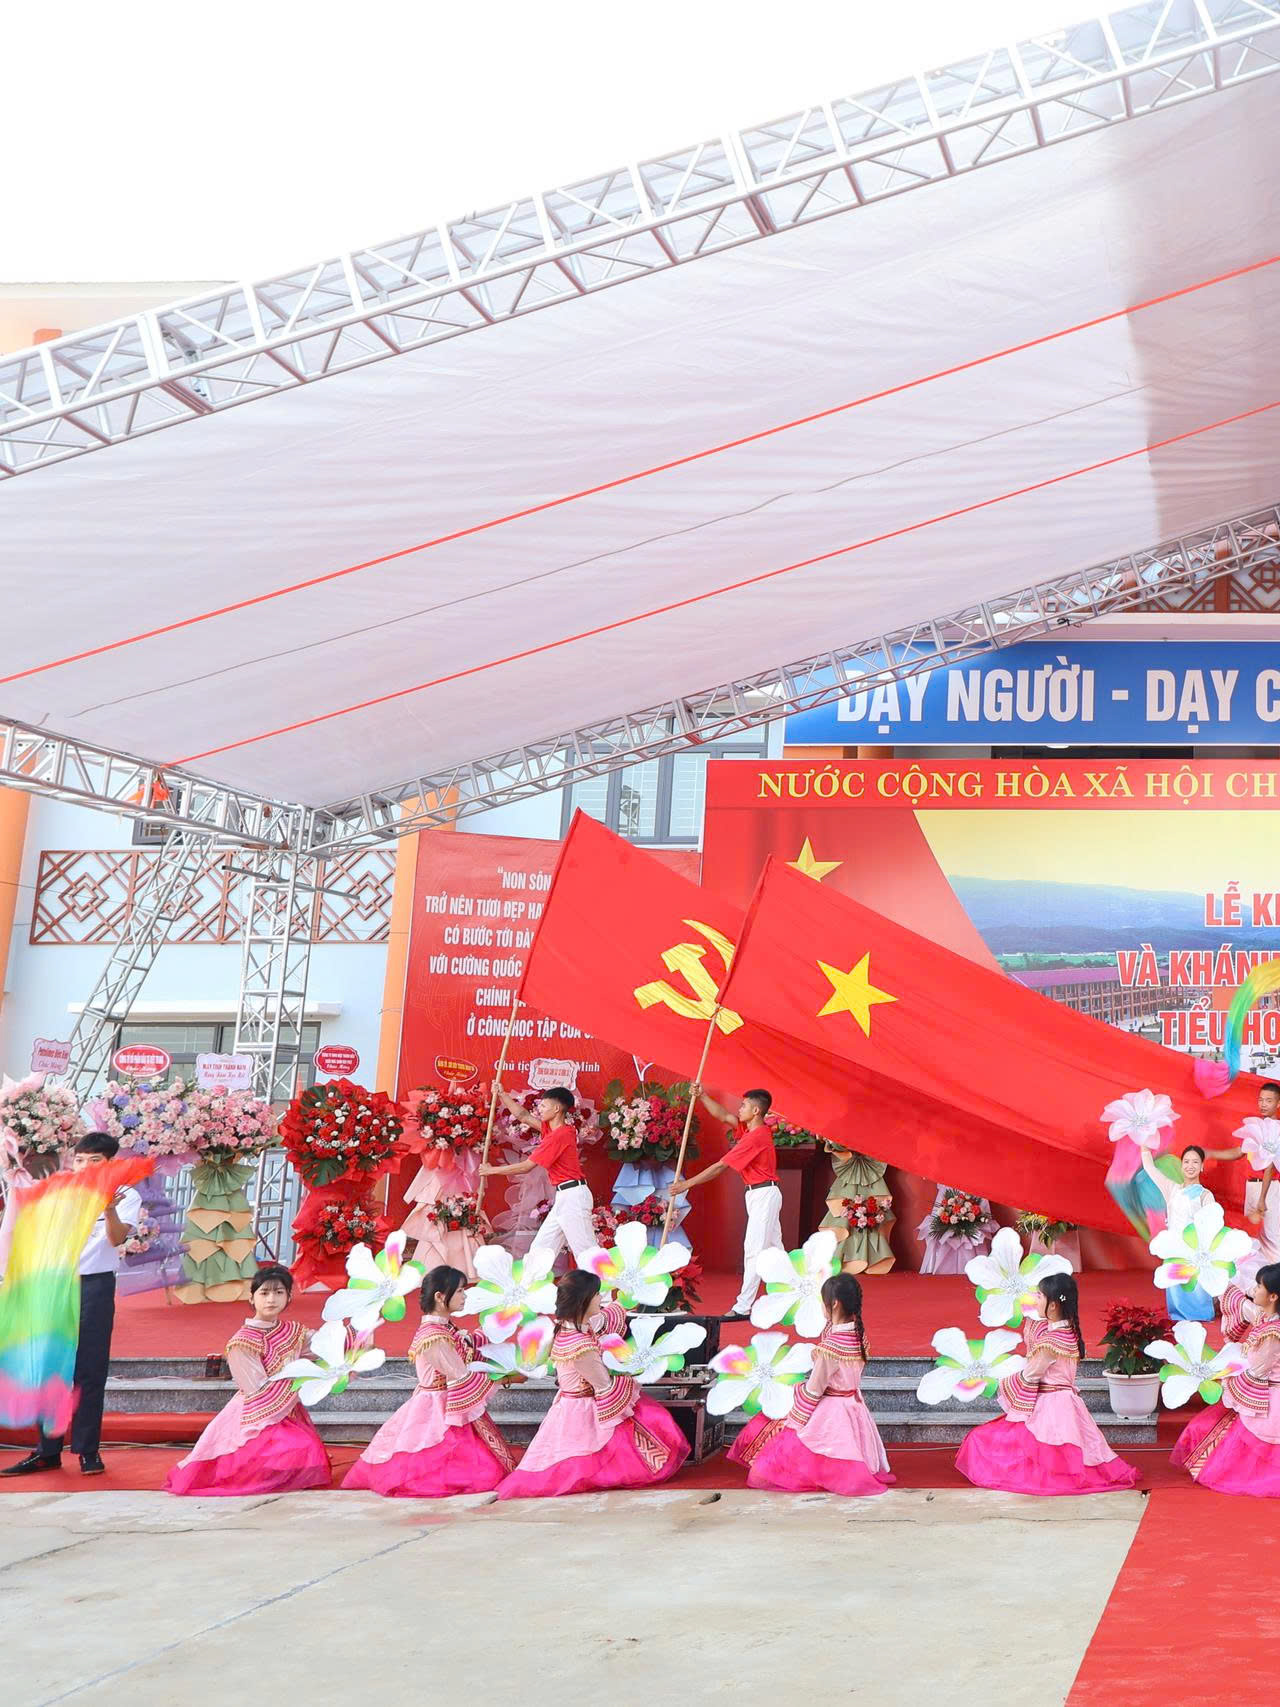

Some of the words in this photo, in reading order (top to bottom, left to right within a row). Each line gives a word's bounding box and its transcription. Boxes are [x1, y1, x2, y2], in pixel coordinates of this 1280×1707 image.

[837, 670, 933, 734] DẠY
[947, 656, 1095, 722] NGƯỜI
[1112, 689, 1129, 701] -
[1146, 669, 1239, 733] DẠY
[757, 765, 866, 798] NƯỚC
[876, 765, 984, 804] CỘNG
[994, 765, 1075, 798] HÒA
[1084, 766, 1134, 797] XÃ
[1145, 765, 1214, 805] HỘI
[529, 871, 552, 891] SÔN
[425, 891, 447, 914] TRỞ
[450, 894, 474, 916] NÊN
[476, 898, 501, 918] TƯƠI
[504, 900, 526, 922] ĐẸP
[528, 902, 544, 919] HA
[1205, 881, 1241, 928] LỄ
[444, 926, 460, 945] CÓ
[463, 926, 493, 947] BƯỚC
[496, 927, 513, 948] TỚI
[429, 954, 448, 975] VỚI
[451, 955, 489, 977] CƯỜNG
[493, 953, 522, 978] QUỐC
[1116, 943, 1161, 987] VÀ
[476, 985, 510, 1007] CHÍNH
[467, 1012, 476, 1036] Ở
[478, 1015, 509, 1037] CÔNG
[512, 1018, 534, 1041] HỌC
[537, 1016, 558, 1041] TẬP
[1158, 996, 1226, 1047] TIỂU
[518, 1060, 530, 1073] tịc
